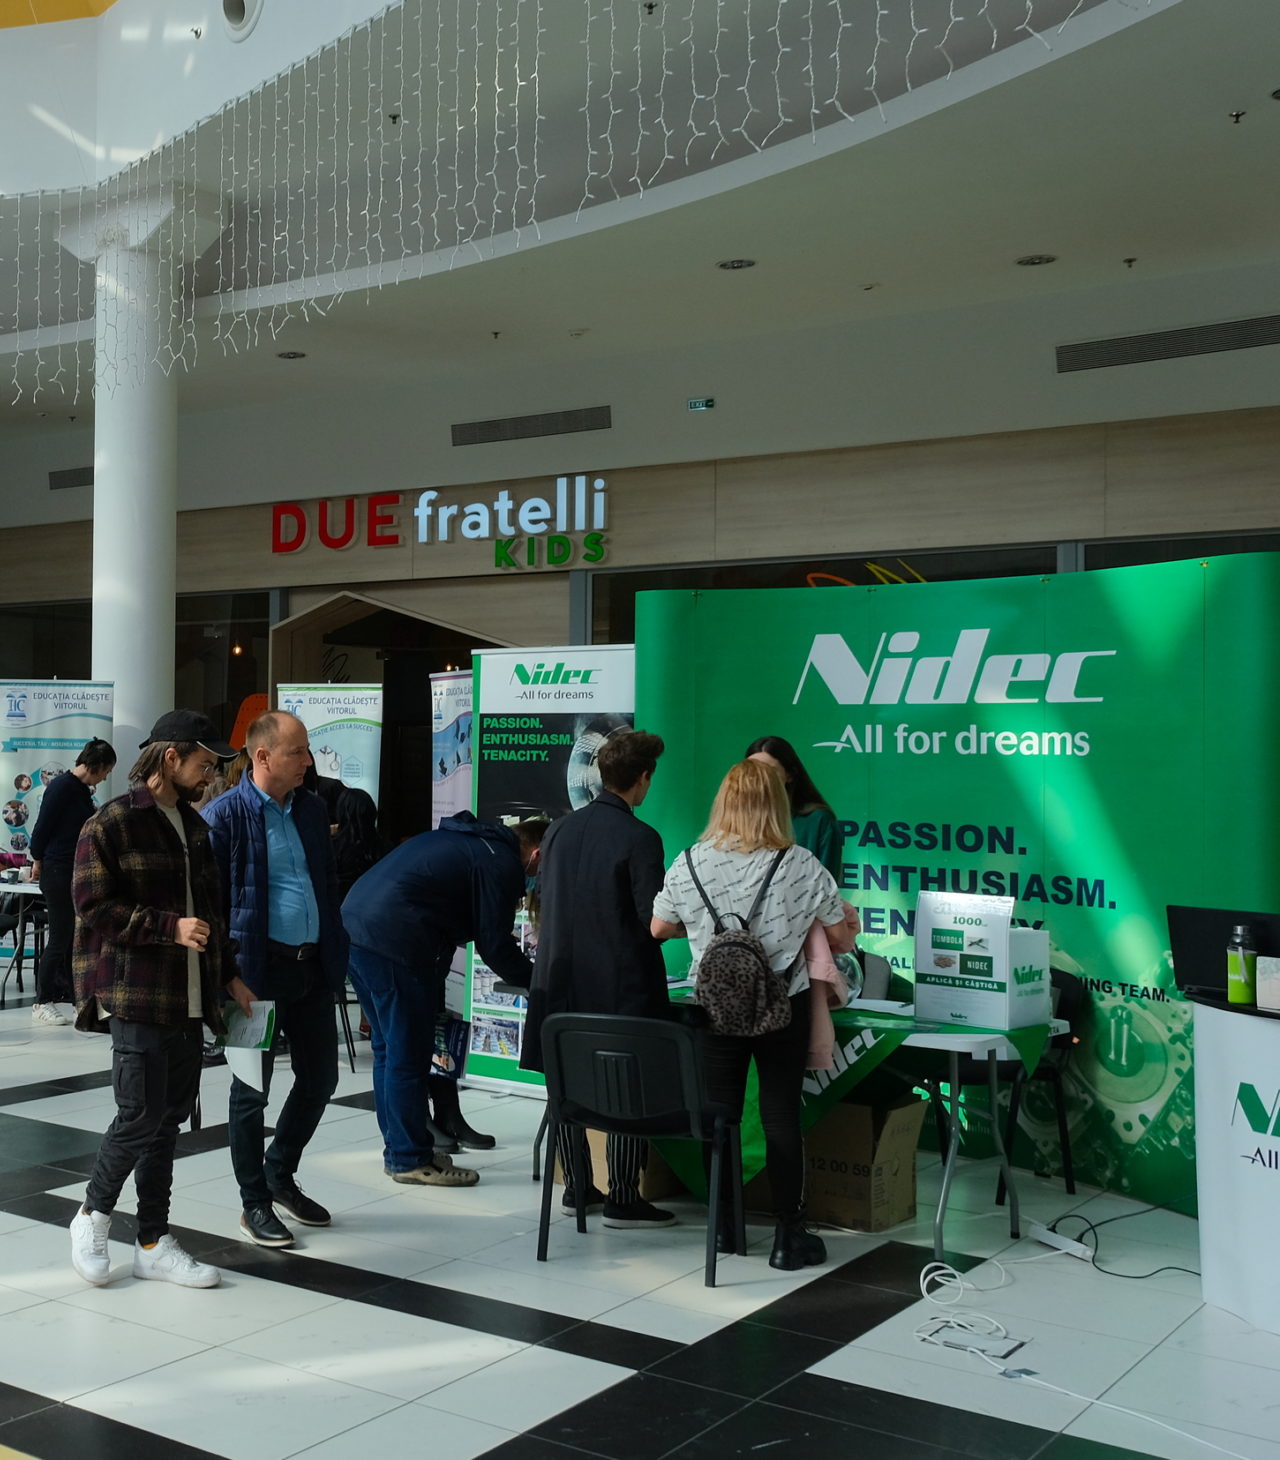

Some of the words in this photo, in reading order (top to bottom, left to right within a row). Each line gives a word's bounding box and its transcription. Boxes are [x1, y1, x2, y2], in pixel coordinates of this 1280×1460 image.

[272, 494, 400, 553] DUE
[414, 475, 606, 543] fratelli
[494, 532, 605, 567] KIDS
[792, 628, 1117, 705] Nidec
[510, 662, 603, 686] Nidec
[517, 690, 535, 700] All
[538, 690, 552, 700] for
[553, 690, 594, 700] dreams
[53, 702, 88, 710] VIITORUL
[327, 707, 357, 715] VIITORUL
[483, 717, 544, 729] PASSION.
[482, 733, 575, 746] ENTHUSIASM.
[812, 724, 883, 753] All
[894, 723, 947, 754] for
[954, 724, 1091, 756] dreams
[482, 749, 549, 762] TENACITY.
[841, 820, 1027, 856] PASSION.
[842, 863, 1117, 910] ENTHUSIASM.
[953, 916, 982, 926] 1000
[932, 934, 963, 945] TOMBOLA
[967, 961, 988, 971] NIDEC
[1118, 982, 1170, 1003] TEAM.
[1240, 1147, 1279, 1170] All
[830, 1160, 848, 1174] 00
